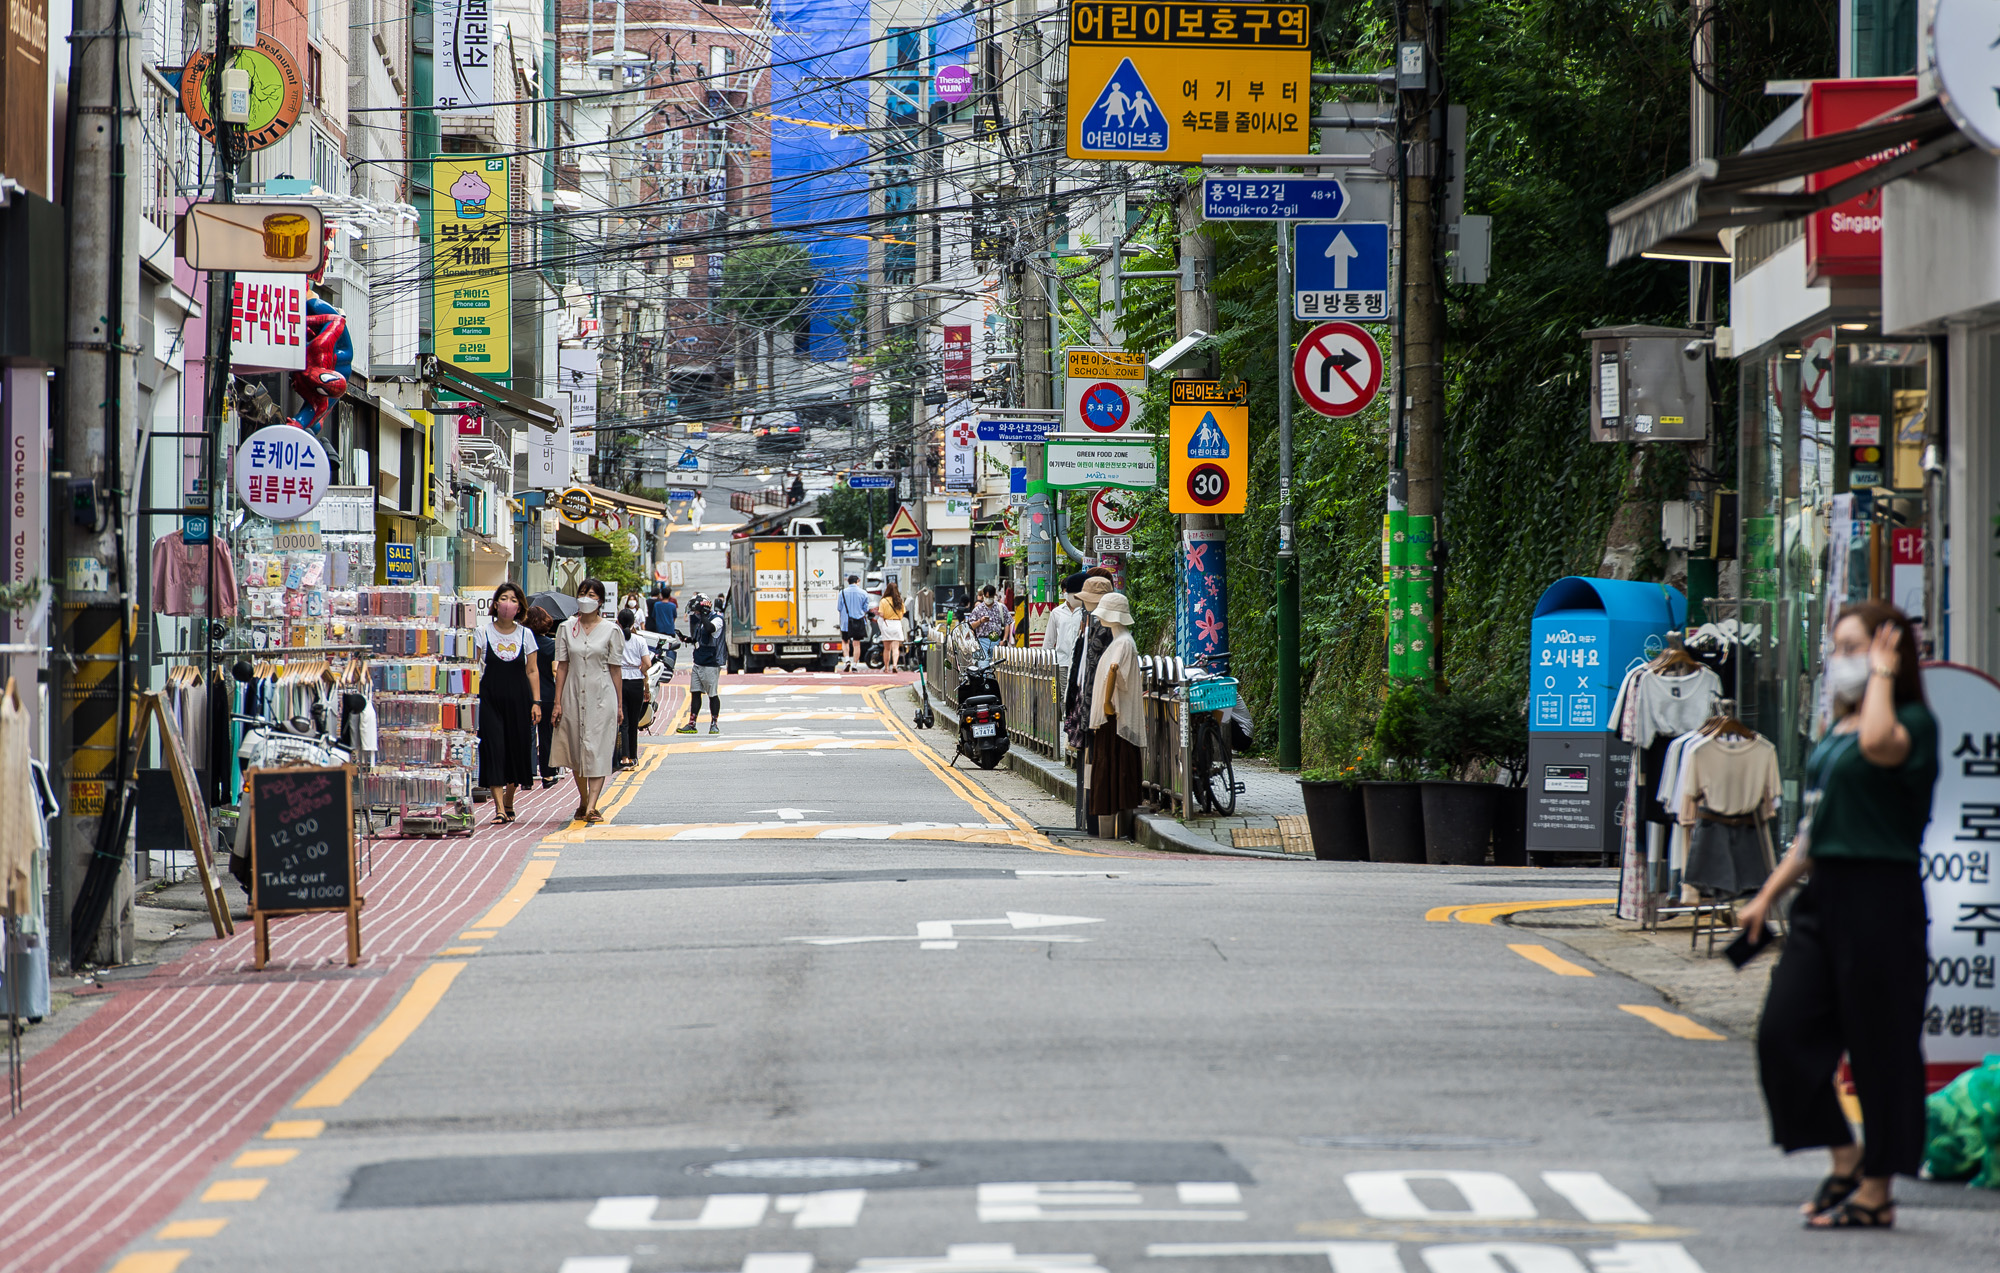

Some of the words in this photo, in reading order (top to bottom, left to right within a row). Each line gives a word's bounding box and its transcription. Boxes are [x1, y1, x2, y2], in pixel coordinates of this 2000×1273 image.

[1077, 5, 1303, 43] 어린이보호구역
[257, 37, 298, 85] Restaurant
[938, 76, 971, 85] Therapist
[438, 97, 459, 110] 3F
[1182, 110, 1229, 132] 속도를
[1234, 111, 1298, 134] 줄이시오
[194, 118, 289, 149] SNTI
[1087, 131, 1163, 148] 어린이보호
[487, 160, 502, 171] 2F
[1209, 183, 1286, 201] 홍익로2길
[1209, 203, 1269, 216] Hongik-ro
[1271, 203, 1298, 216] 2-gil
[1831, 211, 1883, 234] Singap
[441, 223, 500, 241] 보노보
[452, 247, 490, 265] 카페
[453, 289, 490, 298] 폰케이스
[1302, 293, 1382, 314] 일방통행
[458, 316, 486, 326] 마리모
[458, 343, 486, 353] 슬라임
[1074, 367, 1110, 376] SCHOOL
[1115, 368, 1139, 377] ZONE
[999, 424, 1059, 433] 와우산로29바길
[250, 440, 316, 471] 폰케이스
[1190, 448, 1227, 457] 어린이보호
[1049, 461, 1076, 469] 여기부터는
[1076, 461, 1094, 469] 어린이
[1194, 474, 1222, 495] 30
[1855, 474, 1879, 484] VISA
[248, 474, 314, 505] 필름부착
[188, 497, 206, 505] VISA
[278, 522, 314, 535] SALE
[275, 534, 315, 549] 10000
[1095, 538, 1130, 550] 일방통행
[388, 546, 411, 559] SALE
[388, 562, 412, 574] ₩5000
[261, 871, 298, 886] Take
[300, 872, 327, 883] out
